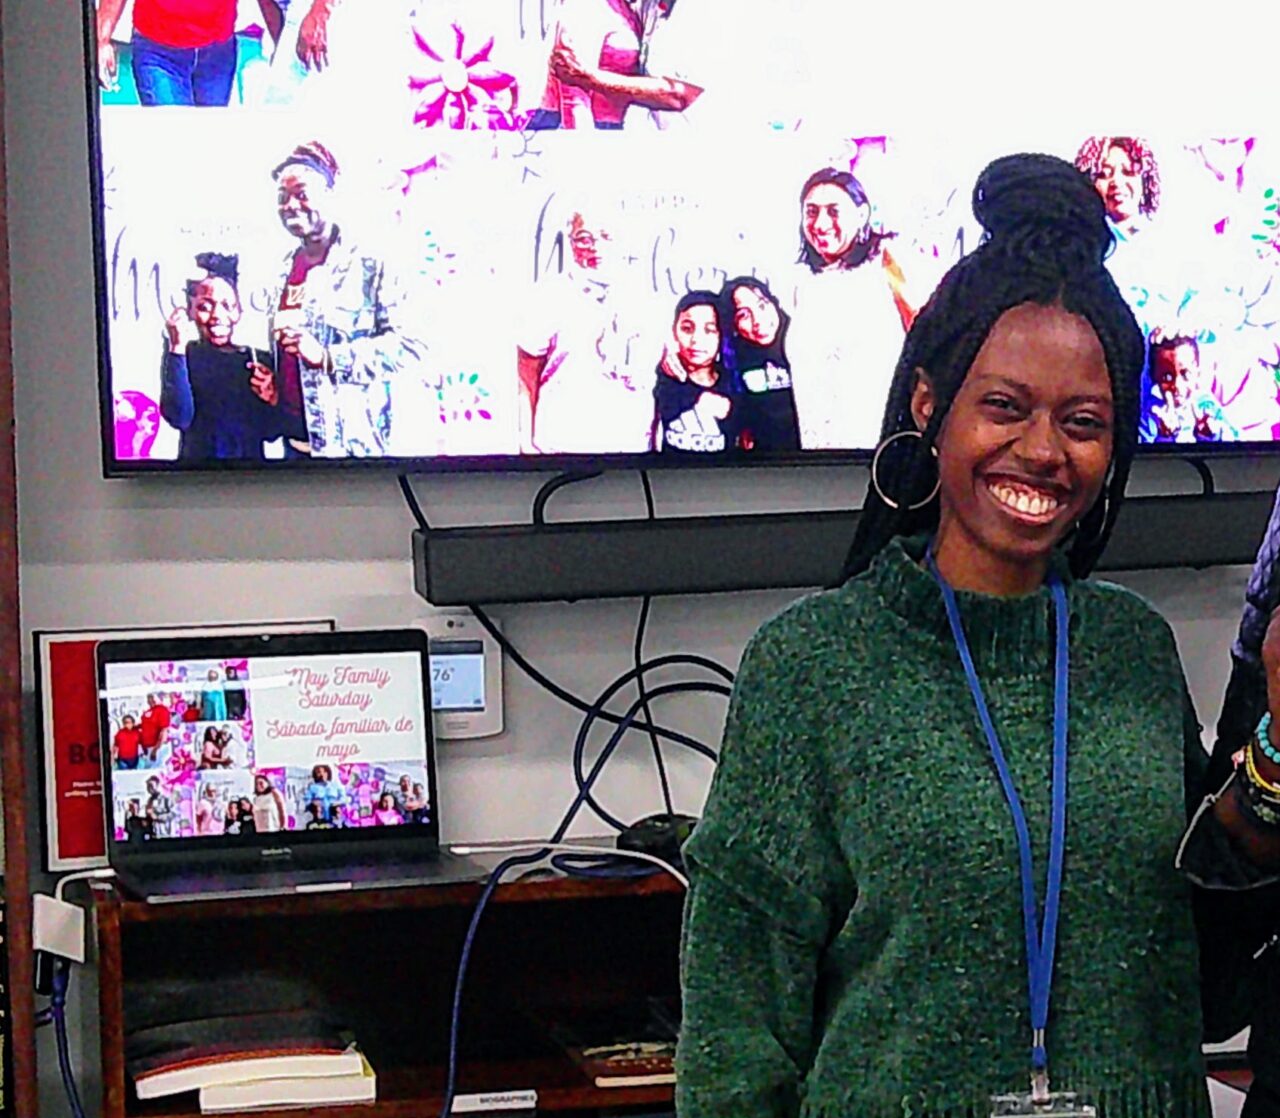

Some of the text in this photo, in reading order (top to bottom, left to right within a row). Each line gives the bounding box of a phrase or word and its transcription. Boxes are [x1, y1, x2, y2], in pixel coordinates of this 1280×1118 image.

[287, 666, 391, 688] May Family
[298, 690, 373, 711] Saturday
[267, 717, 413, 741] Sábado familiar de
[316, 743, 360, 758] mayo
